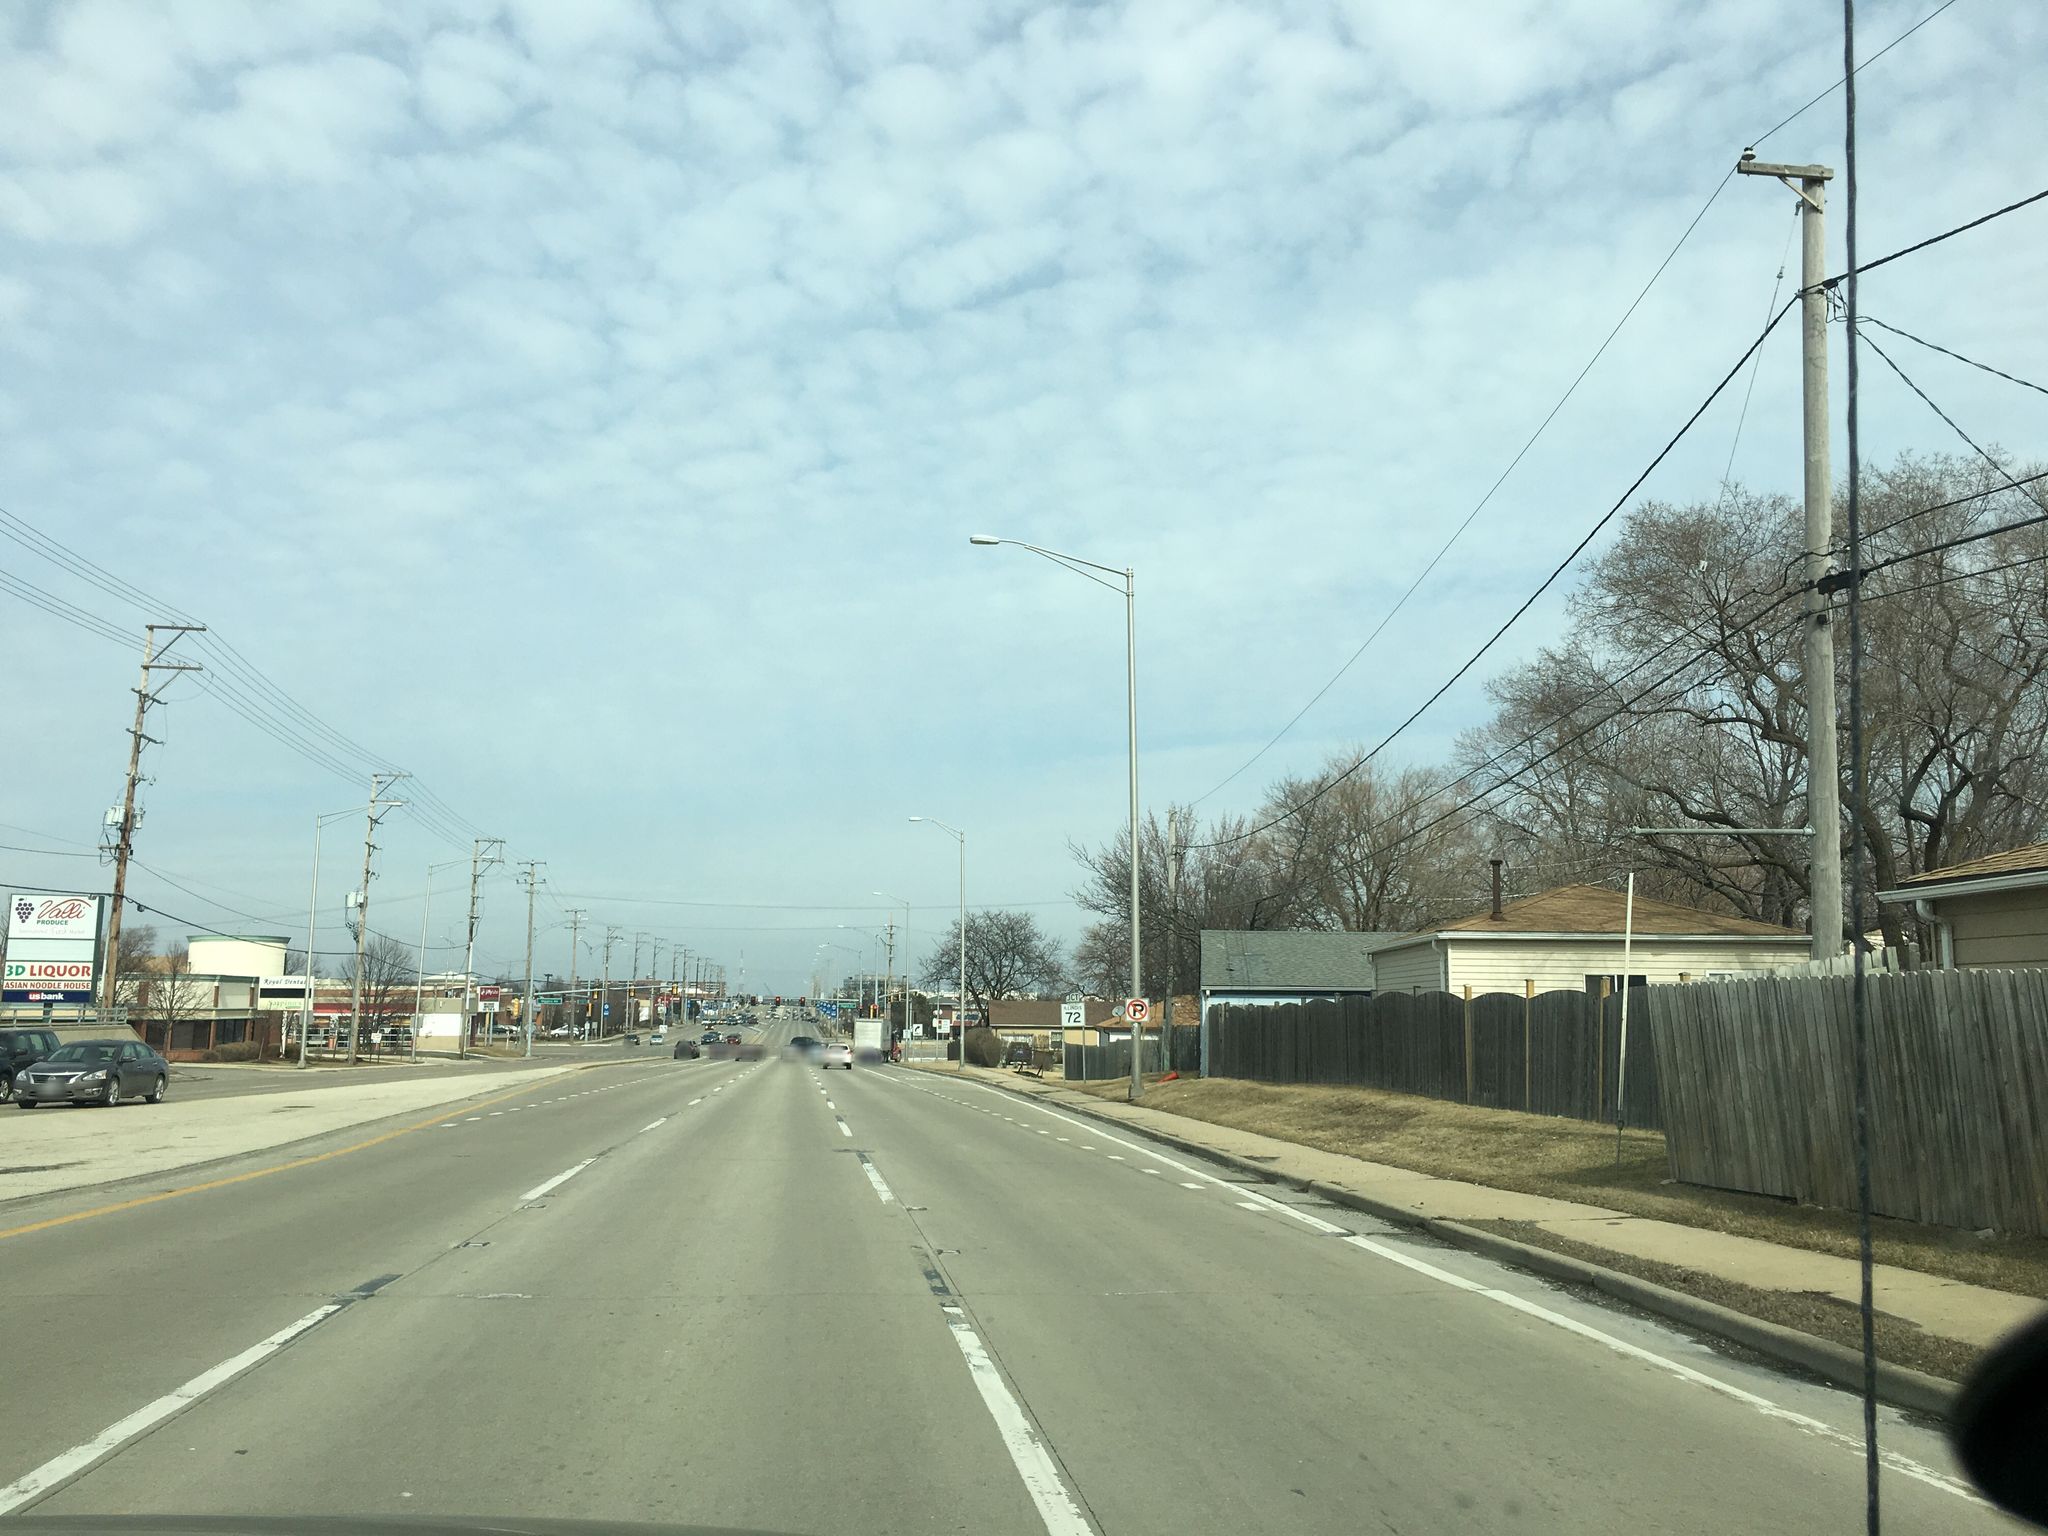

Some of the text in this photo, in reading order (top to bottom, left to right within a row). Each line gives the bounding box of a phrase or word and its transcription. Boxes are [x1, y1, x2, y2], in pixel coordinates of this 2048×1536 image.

[38, 899, 92, 920] Valli
[6, 964, 91, 978] 3D LIQUOR
[4, 981, 91, 990] ASIAN NOODLE HOUSE
[1066, 993, 1079, 1001] JCT
[1065, 1011, 1081, 1023] 72
